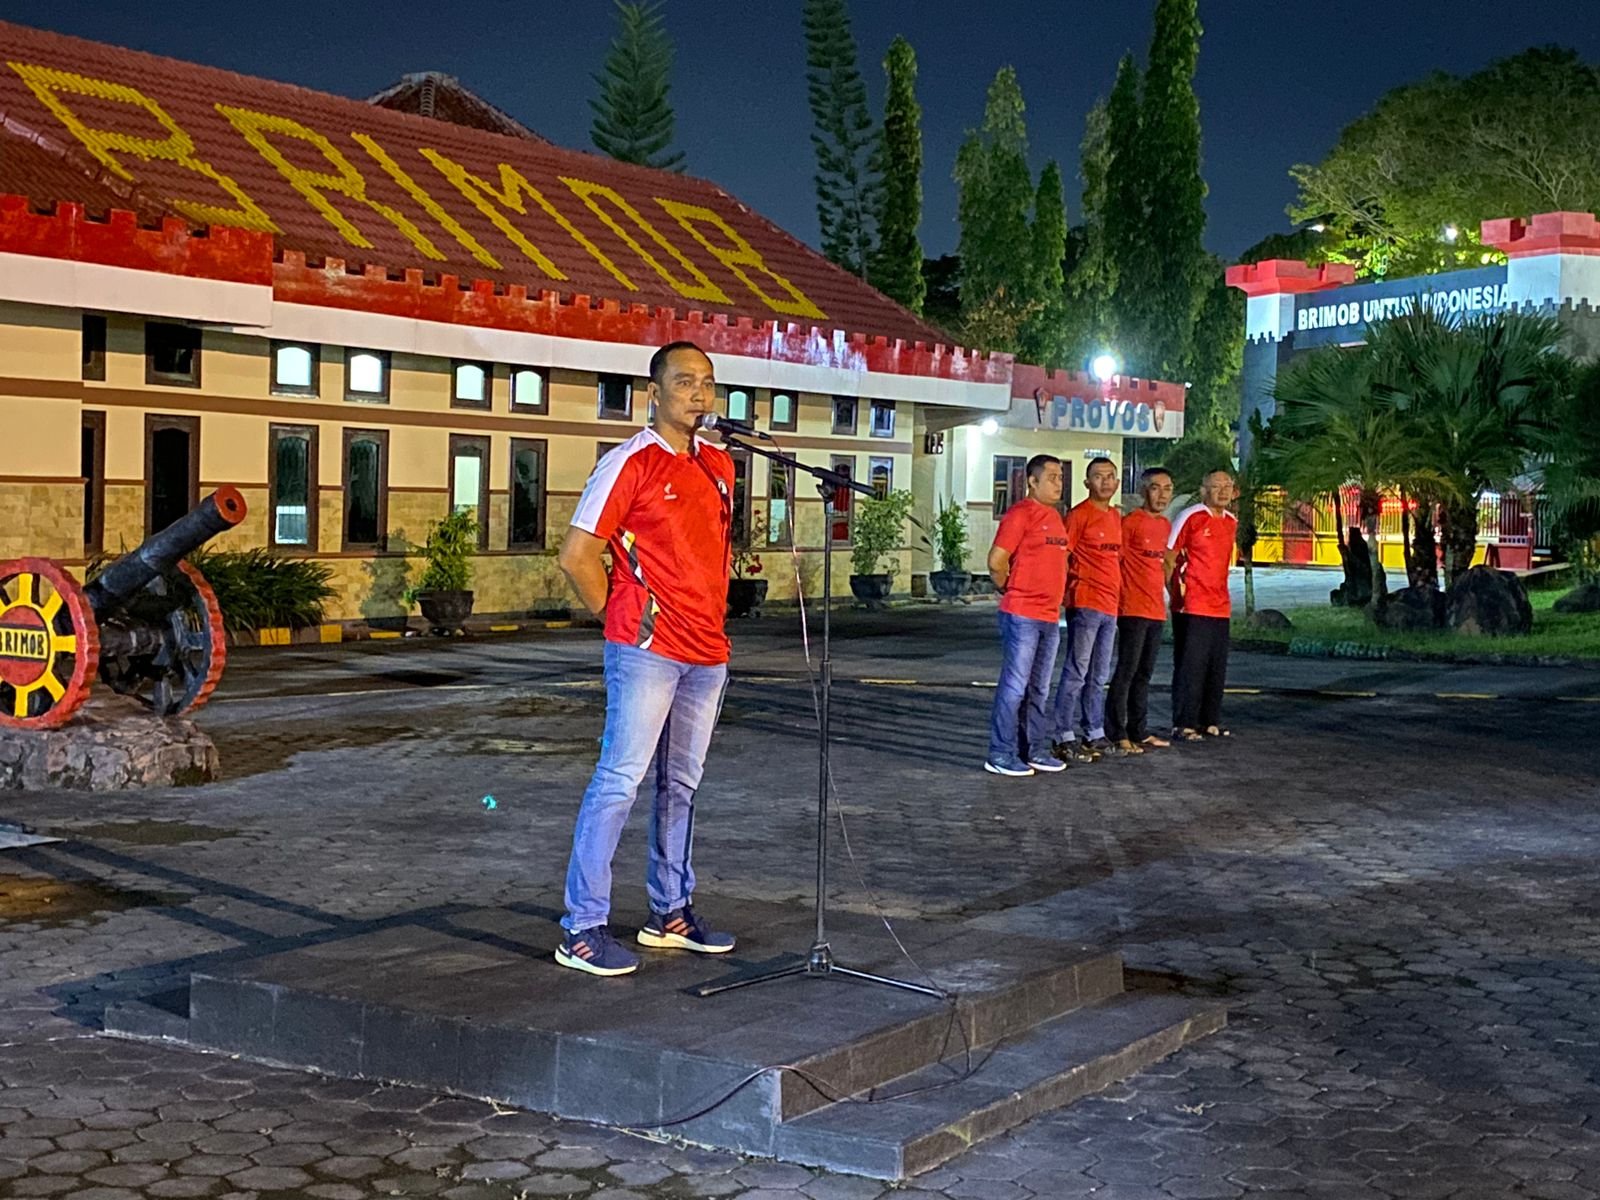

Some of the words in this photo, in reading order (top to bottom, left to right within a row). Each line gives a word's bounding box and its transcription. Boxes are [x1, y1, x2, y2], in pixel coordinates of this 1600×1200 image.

[6, 61, 830, 320] BRIMOB
[1298, 301, 1360, 330] BRIMOB
[1052, 395, 1150, 432] PROVOS
